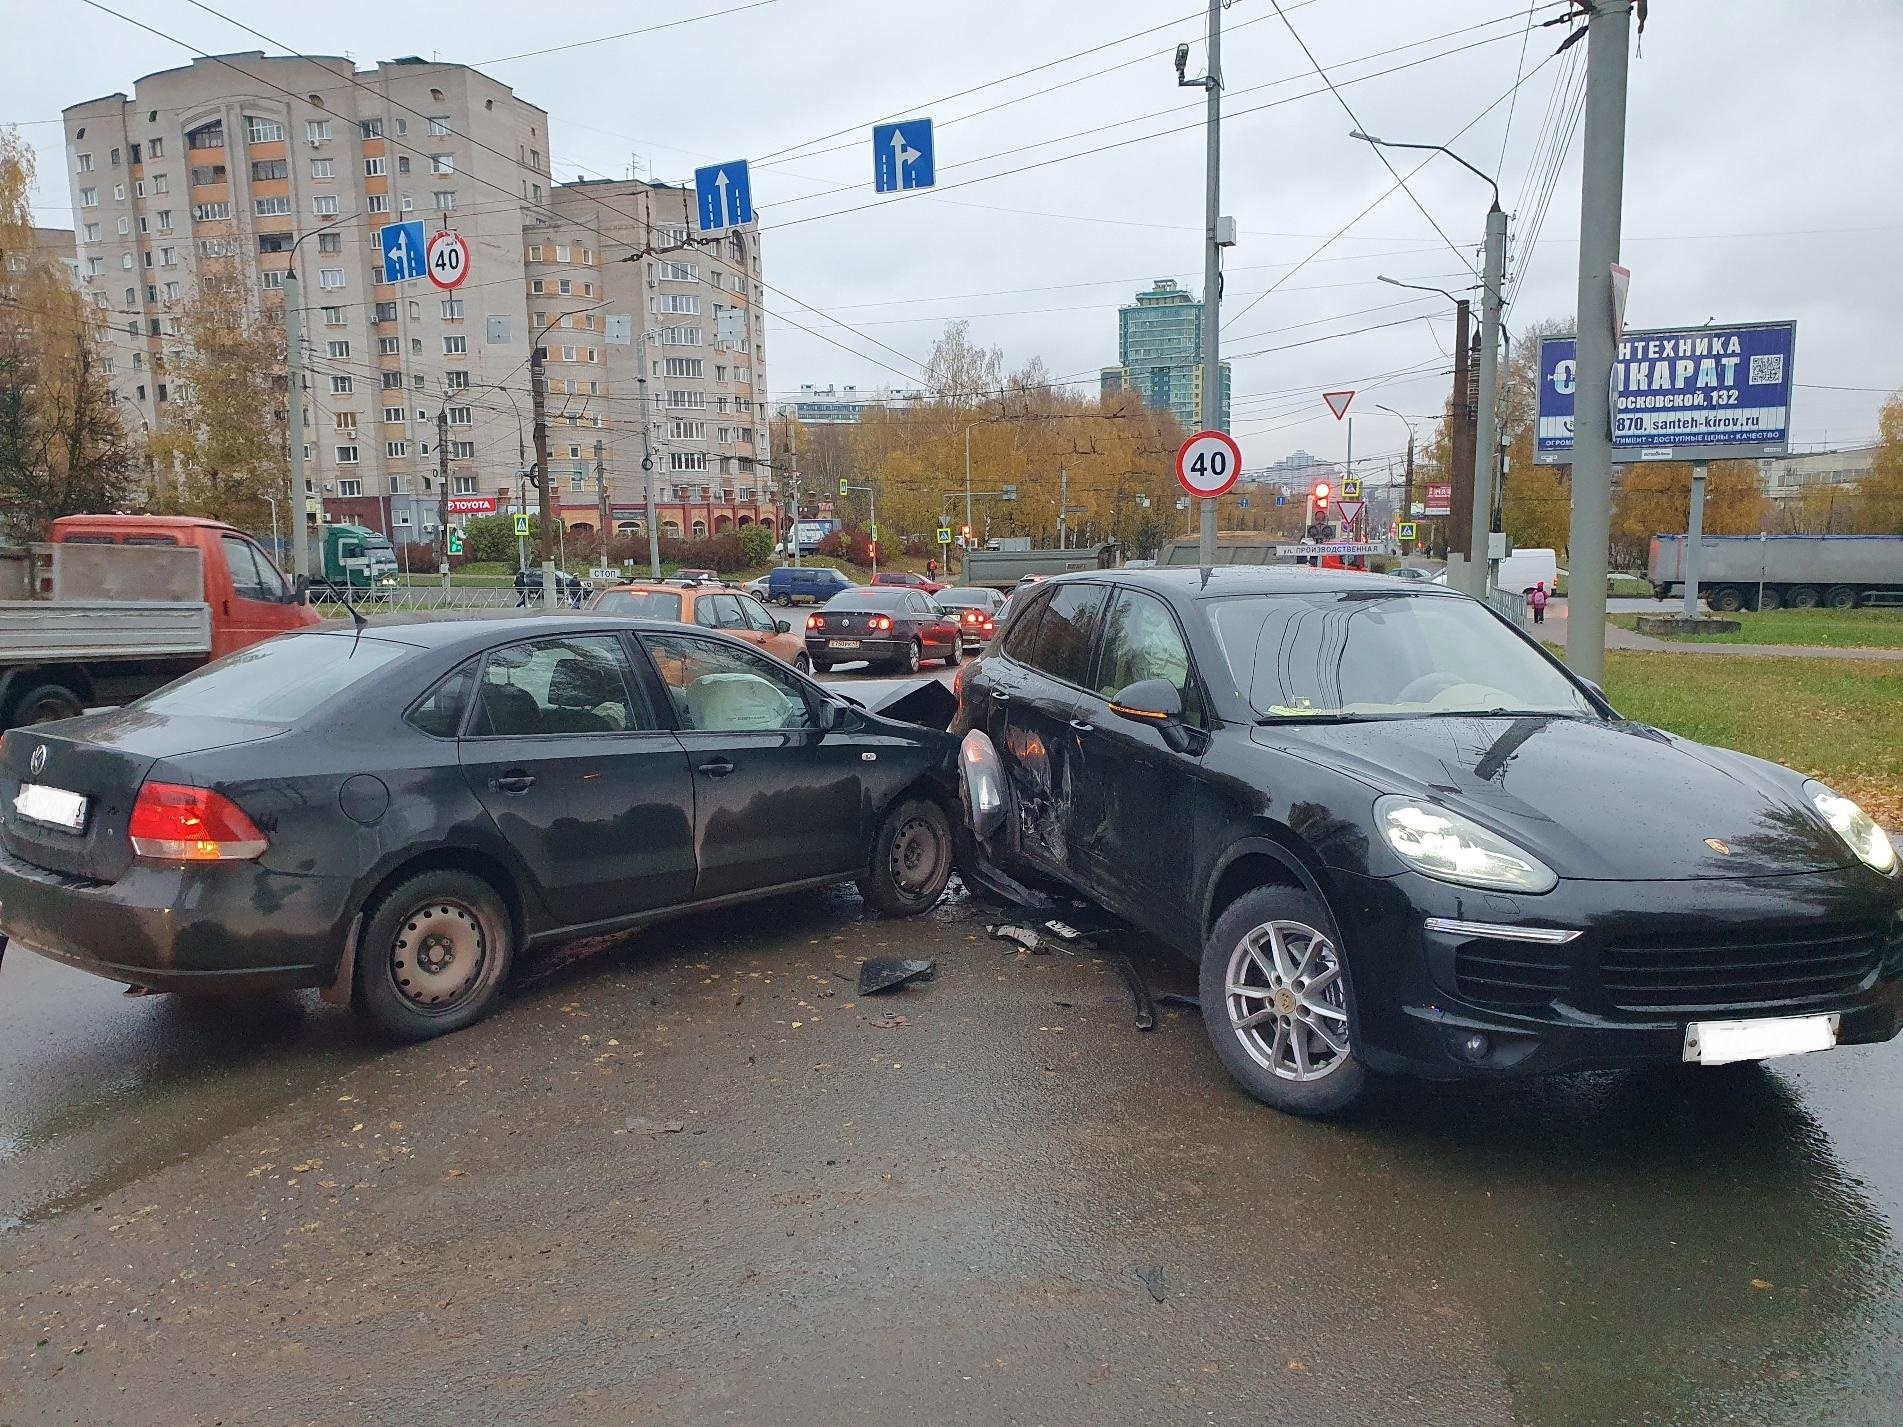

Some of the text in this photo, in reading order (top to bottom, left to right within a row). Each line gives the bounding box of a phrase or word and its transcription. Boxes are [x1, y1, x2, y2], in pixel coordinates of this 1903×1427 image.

[436, 249, 459, 271] 40
[1618, 336, 1741, 359] НТЕХНИКА
[1617, 390, 1738, 409] ОСКОВСКОЙ, 132
[1652, 416, 1760, 430] santeh-kirov.ru
[1616, 436, 1647, 444] ТИМЕНТ
[1653, 435, 1703, 443] ДОСТУПНЫЕ
[1704, 434, 1729, 442] ЦЕНЫ
[1735, 431, 1780, 439] КАЧЕСТВО
[1190, 451, 1227, 476] 40
[455, 500, 490, 510] TOYOTA
[1296, 545, 1378, 554] ПРОИЗВОДСТВЕННАЯ
[594, 570, 616, 578] СТОП
